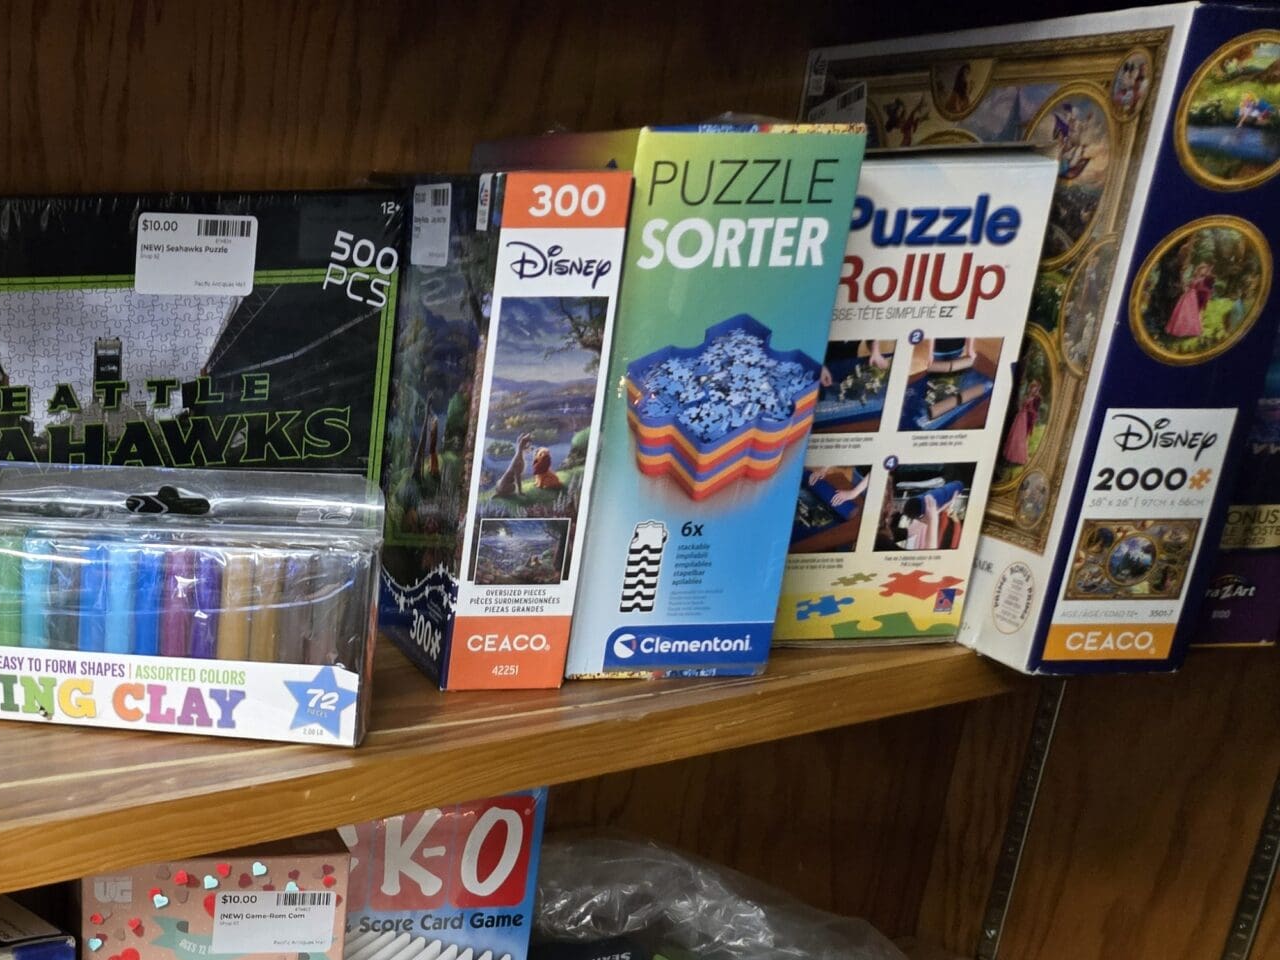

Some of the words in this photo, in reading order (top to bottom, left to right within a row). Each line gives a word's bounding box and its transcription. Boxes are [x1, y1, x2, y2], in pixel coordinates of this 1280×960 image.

[648, 159, 839, 206] PUZZLE
[528, 184, 606, 217] 300
[142, 220, 178, 232] $10.00
[850, 193, 1022, 247] Puzzle
[166, 244, 203, 253] Seahawks
[204, 245, 228, 254] Puzzle
[330, 230, 399, 275] 500
[636, 217, 829, 270] SORTER
[506, 241, 612, 289] Disney
[322, 262, 391, 308] PCS
[912, 332, 921, 342] 2
[1112, 414, 1217, 461] Disney
[886, 458, 896, 469] 4
[1094, 467, 1187, 491] 2000
[681, 521, 704, 537] 6x
[467, 634, 547, 652] CEACO
[640, 634, 750, 654] Clementoni
[1066, 631, 1153, 650] CEACO
[28, 657, 42, 671] TO
[45, 658, 77, 674] FORM
[80, 661, 125, 678] SHAPES
[135, 664, 196, 683] ASSORTED
[200, 668, 245, 686] COLORS
[491, 665, 519, 675] 42251
[112, 683, 246, 729] CLAY
[306, 688, 339, 711] 72
[221, 895, 257, 905] $10.00
[359, 915, 414, 934] Score
[420, 912, 463, 931] Card
[470, 911, 524, 930] Game
